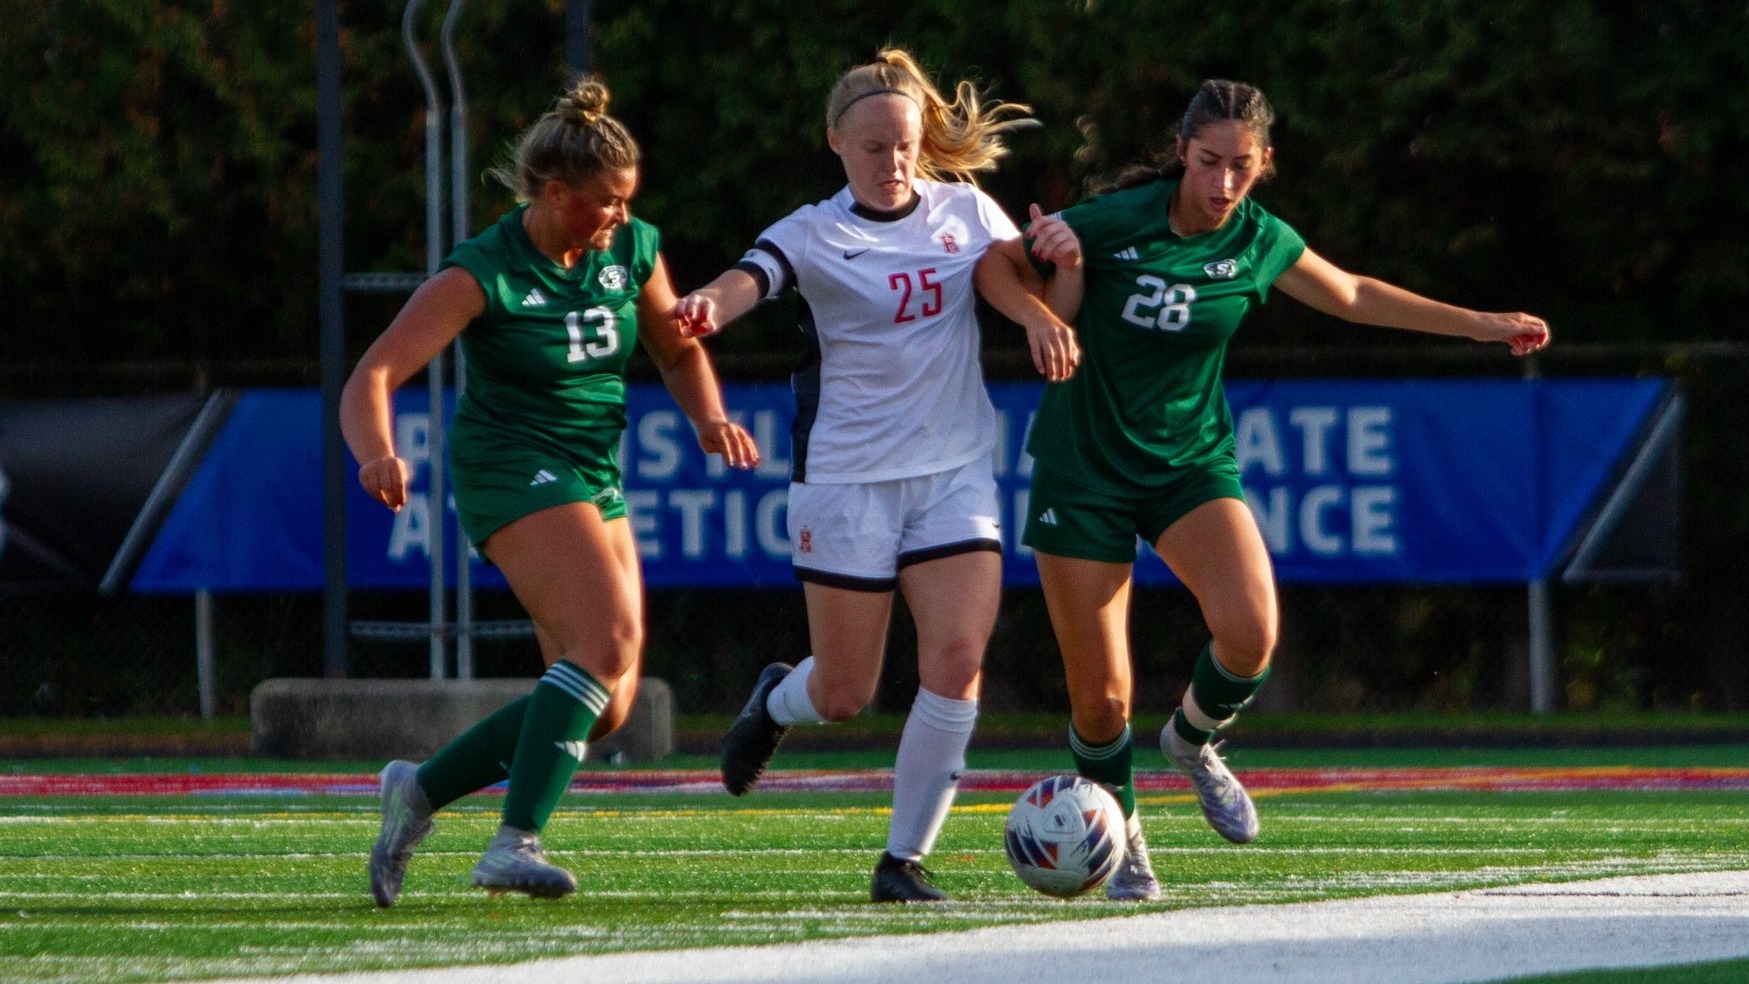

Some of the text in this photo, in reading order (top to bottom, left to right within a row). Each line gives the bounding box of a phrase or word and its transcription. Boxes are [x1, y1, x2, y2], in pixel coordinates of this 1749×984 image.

[888, 267, 943, 324] 25
[1121, 274, 1197, 331] 28
[564, 306, 619, 362] 13
[1236, 405, 1393, 477] ATE
